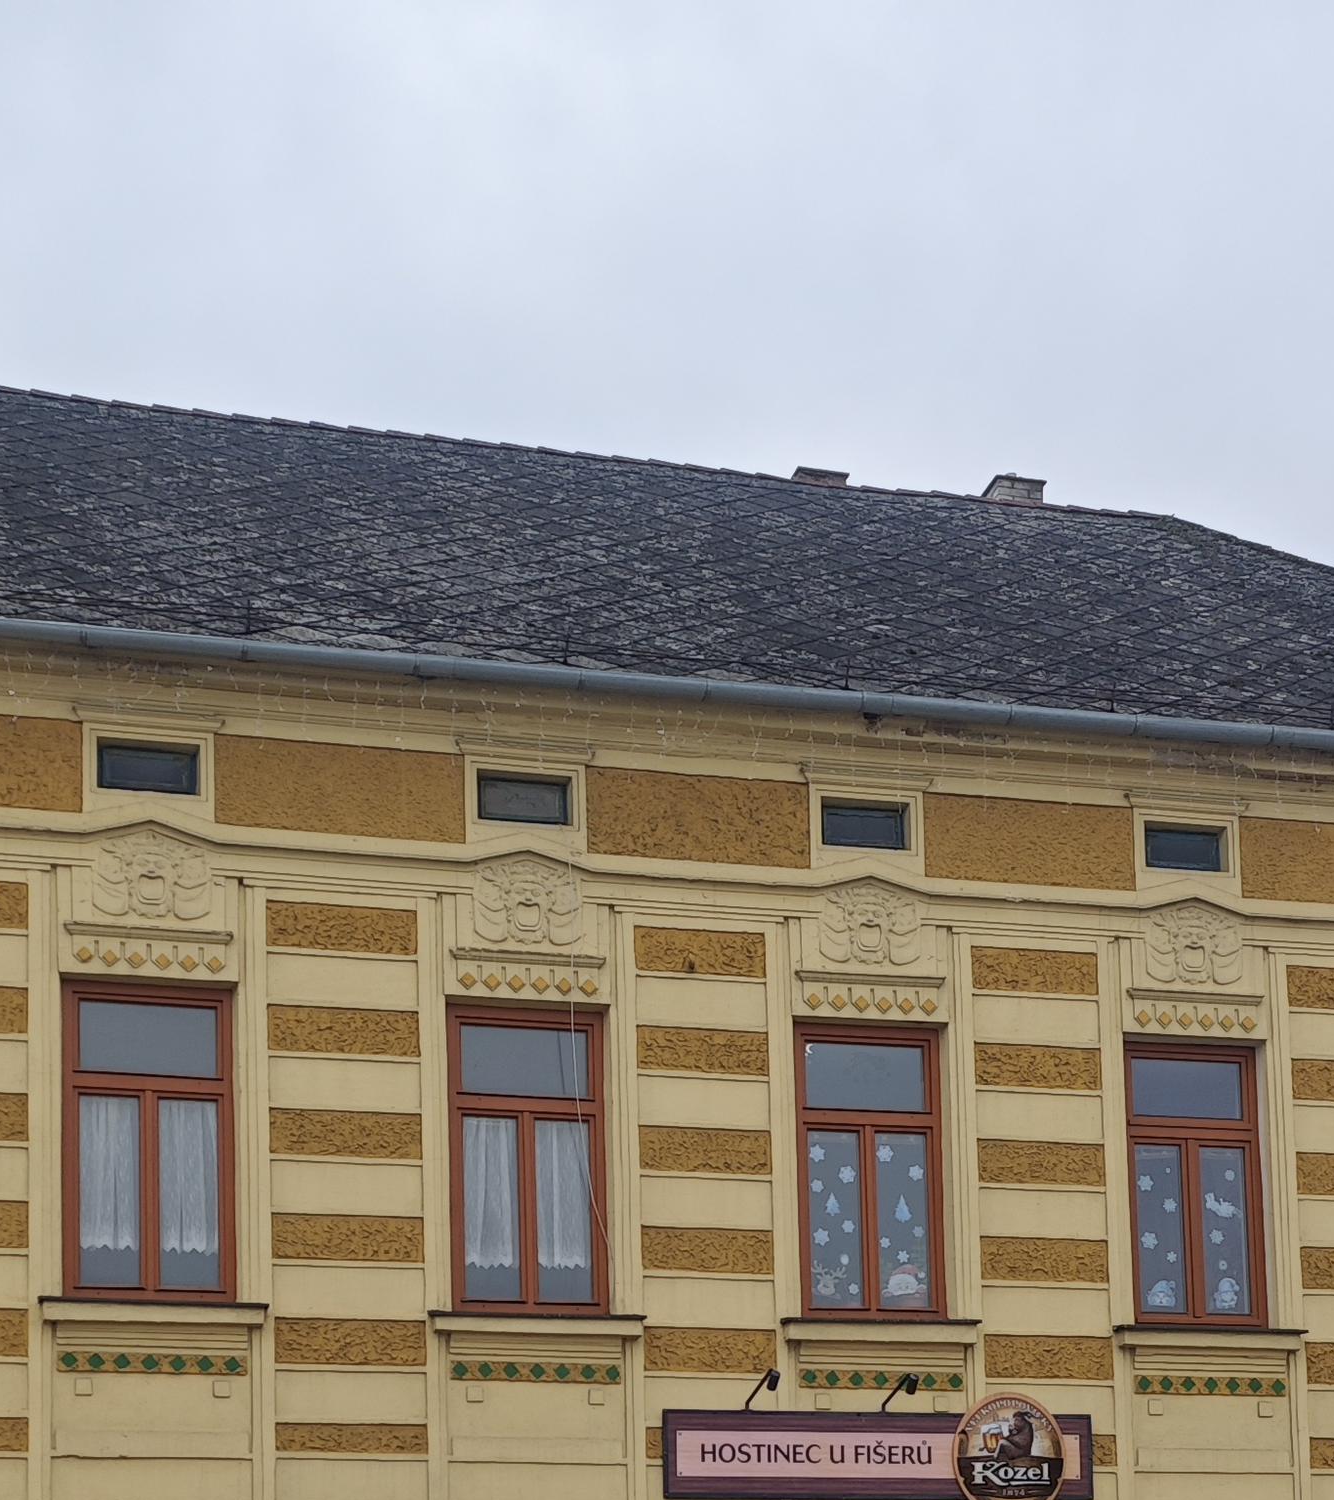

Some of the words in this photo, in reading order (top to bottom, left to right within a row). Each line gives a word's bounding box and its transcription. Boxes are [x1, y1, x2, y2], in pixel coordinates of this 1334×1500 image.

[700, 1443, 822, 1464] HOSTINEC
[829, 1444, 845, 1464] U
[853, 1440, 933, 1465] FIŠERŮ
[970, 1461, 1051, 1487] Kozel
